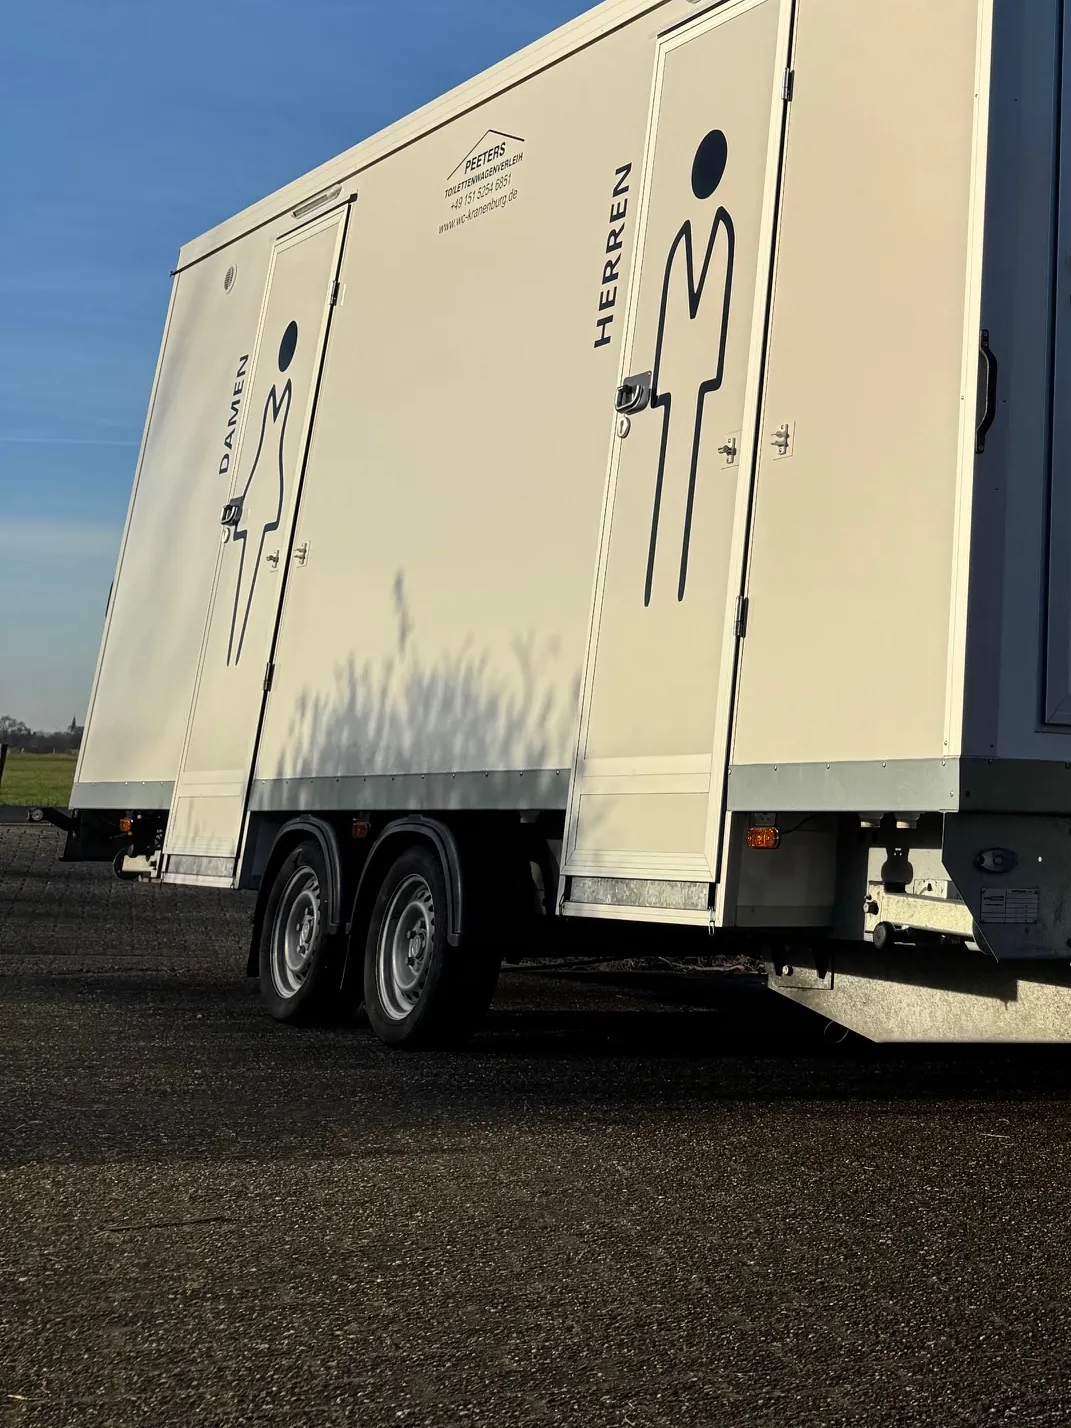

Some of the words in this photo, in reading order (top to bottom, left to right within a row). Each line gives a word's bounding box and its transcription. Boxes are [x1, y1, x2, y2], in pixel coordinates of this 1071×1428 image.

[444, 152, 524, 199] TOILETTENWAGENVERLEIH
[464, 142, 506, 174] PEETERS
[438, 188, 518, 234] www.wc-kranenburg.de
[450, 196, 463, 211] +49
[464, 190, 476, 206] 151
[477, 182, 493, 200] 5254
[495, 172, 512, 191] 6851
[593, 162, 633, 348] HERREN
[218, 354, 249, 475] DAMEN
